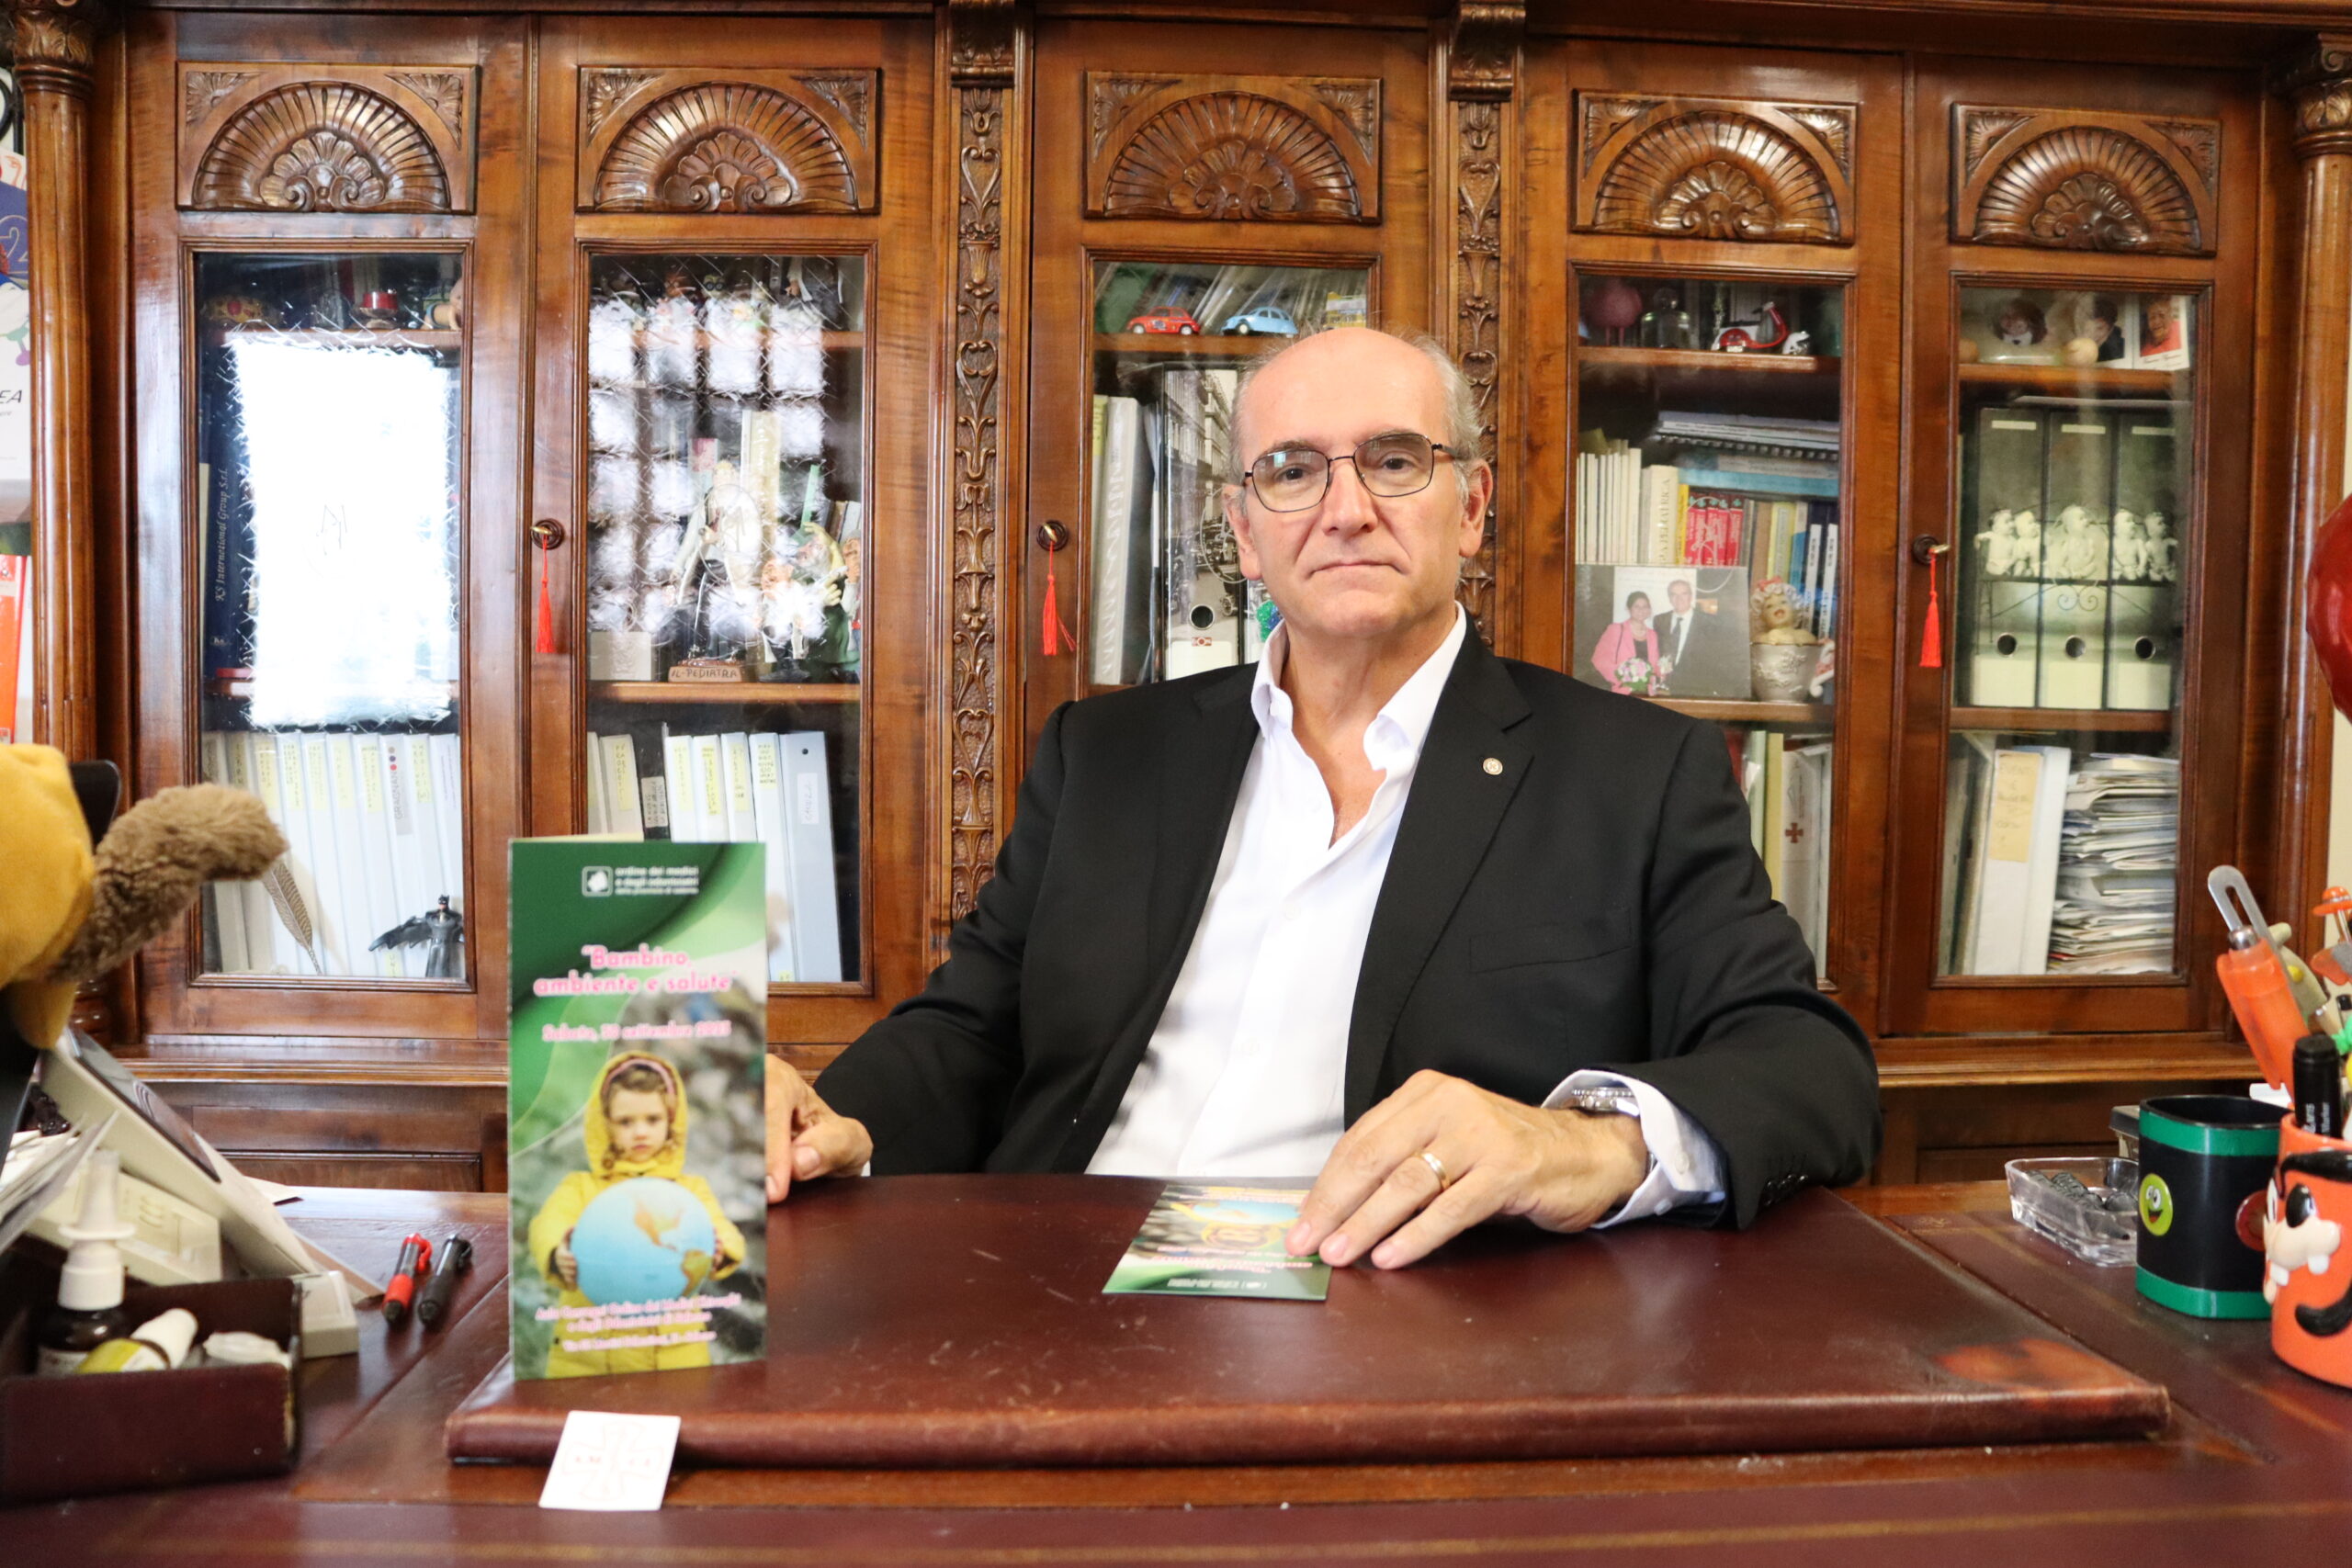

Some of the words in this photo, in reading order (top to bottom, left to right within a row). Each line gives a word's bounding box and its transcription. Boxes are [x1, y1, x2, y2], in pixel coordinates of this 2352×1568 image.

[217, 491, 230, 521] Group
[216, 521, 228, 585] International
[533, 969, 639, 995] ambiente
[646, 977, 660, 992] e
